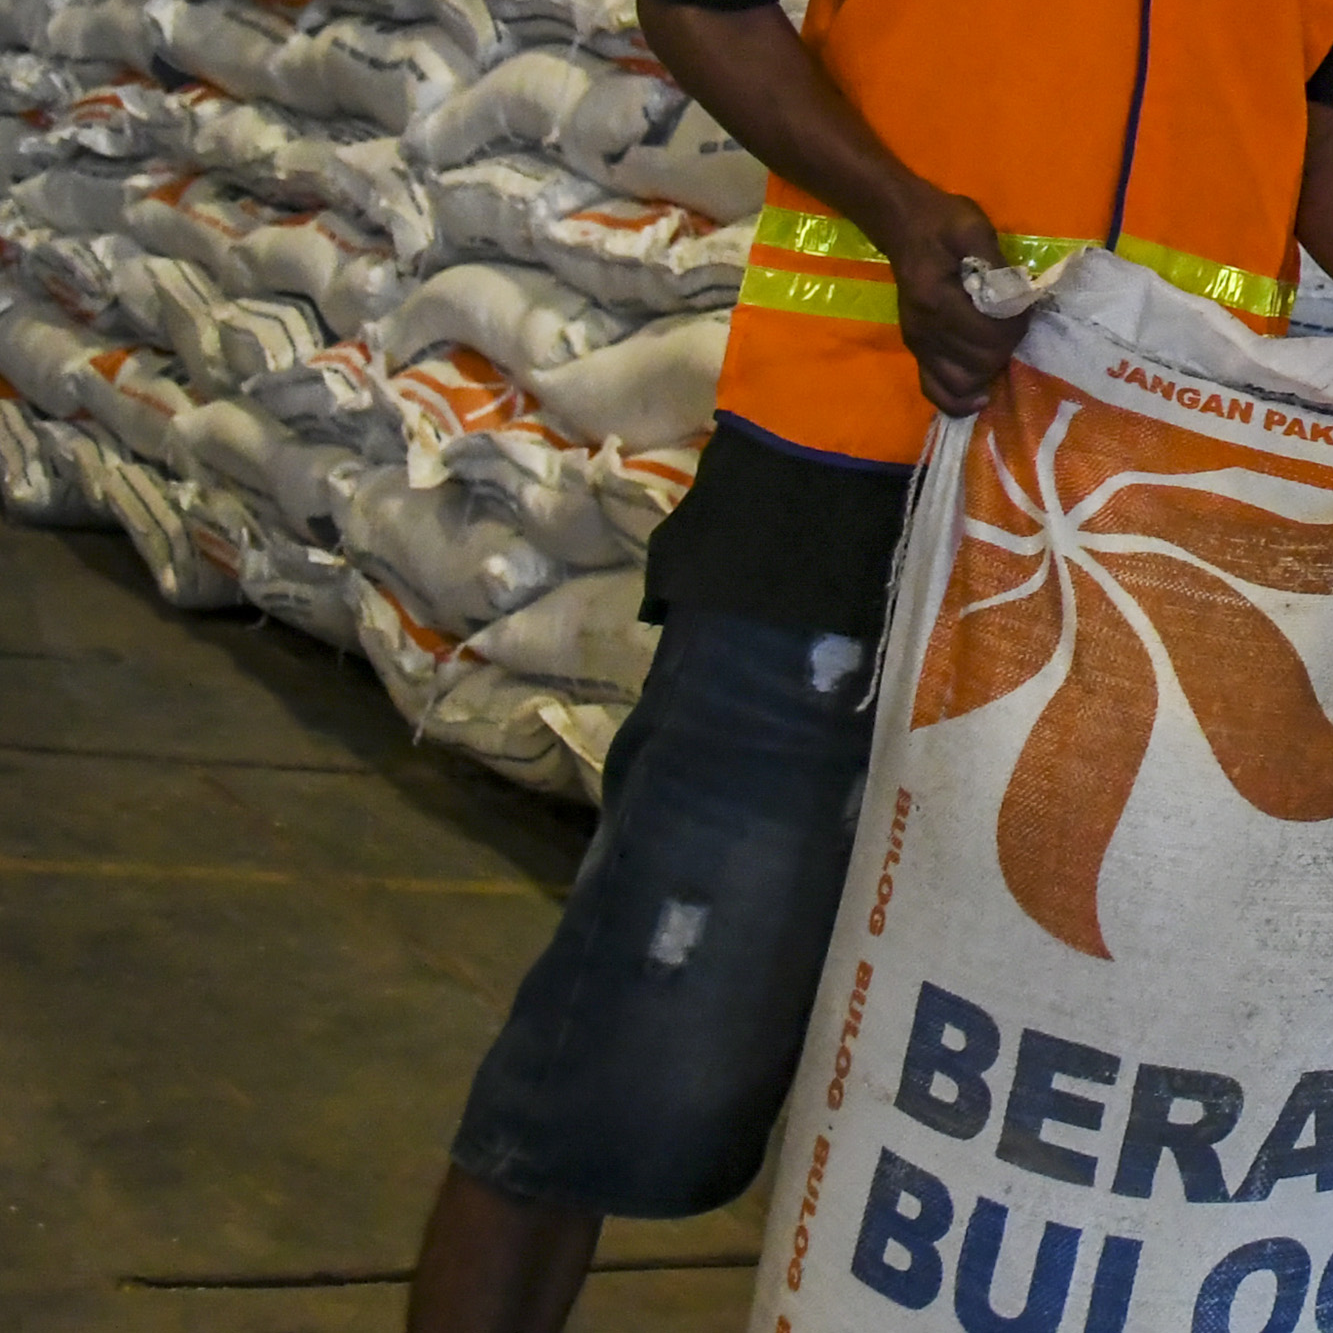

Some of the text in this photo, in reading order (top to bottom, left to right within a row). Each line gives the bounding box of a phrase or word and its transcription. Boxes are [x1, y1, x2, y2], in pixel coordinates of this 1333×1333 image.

[1105, 358, 1254, 425] JANGAN
[787, 786, 913, 1293] BULOG BULOG BULOG
